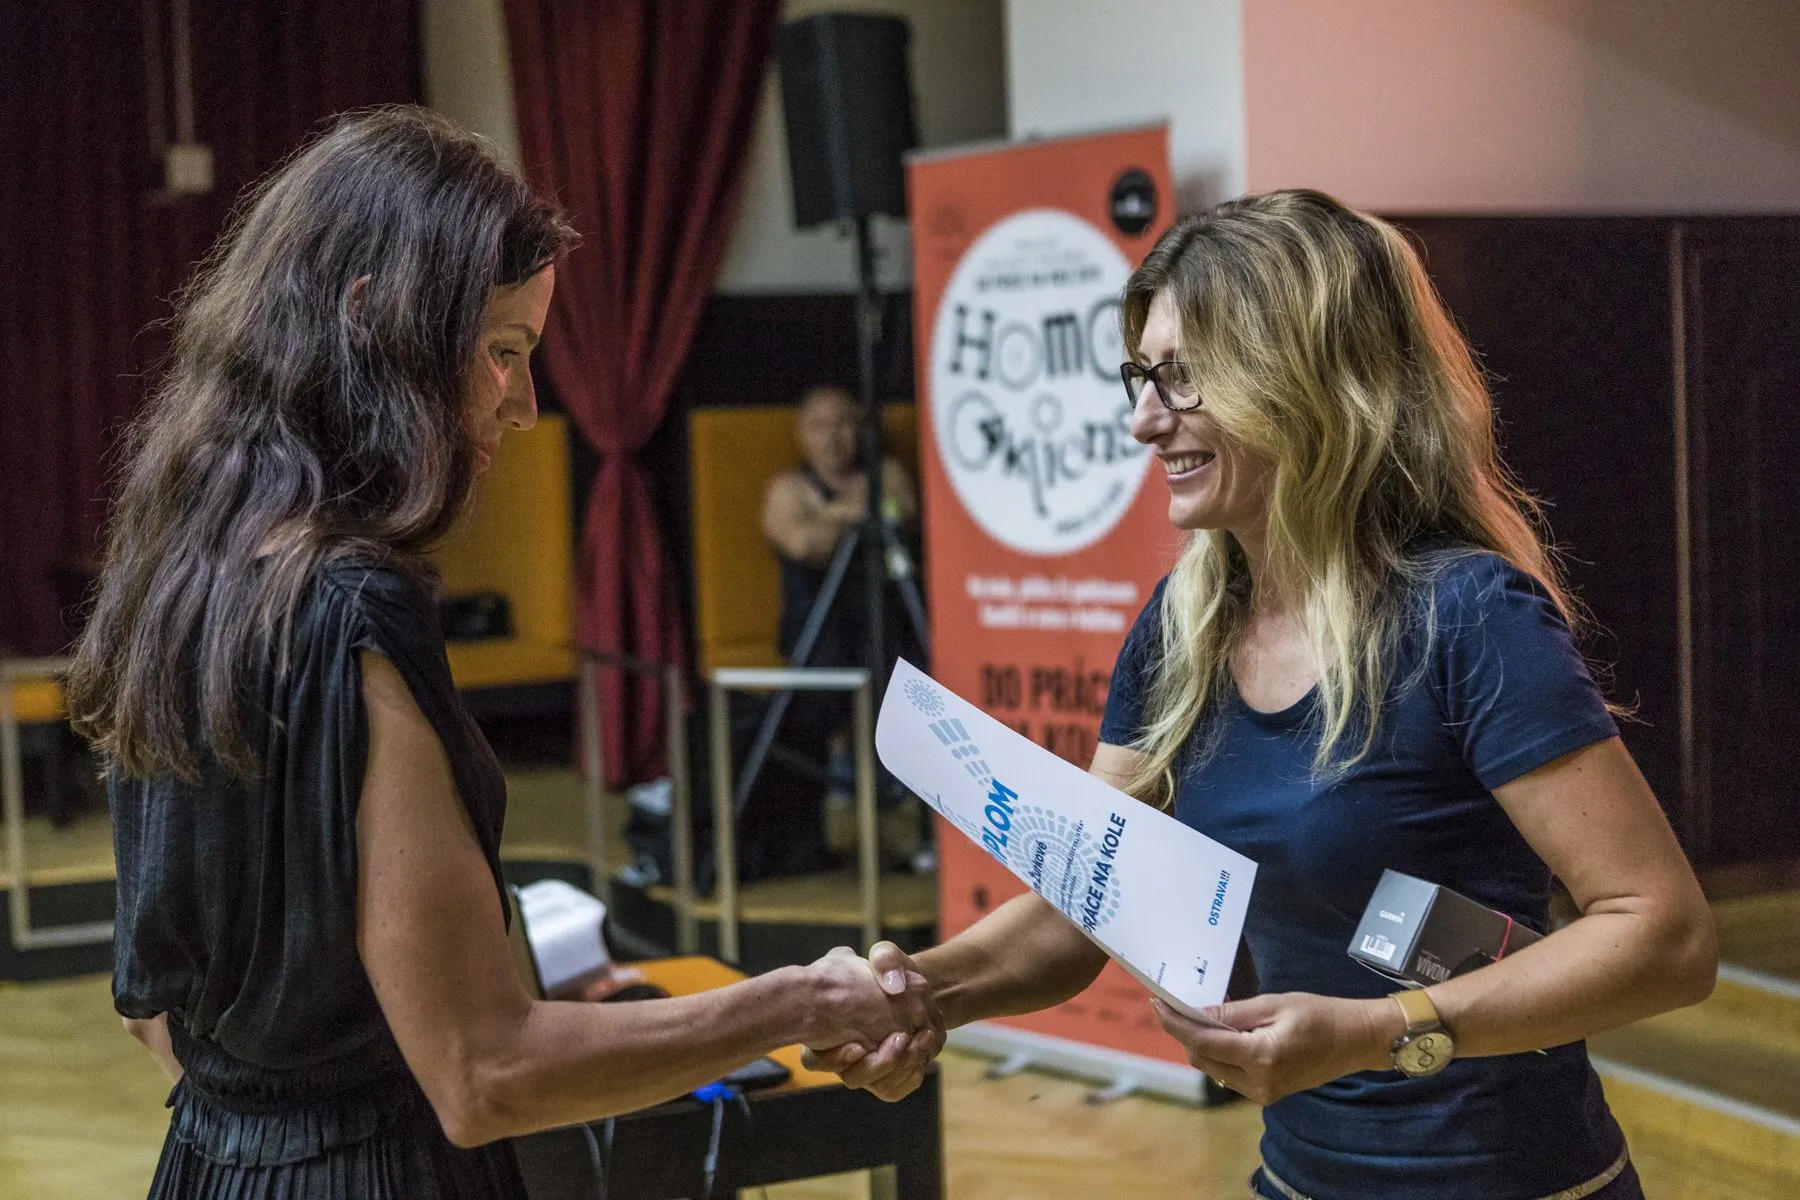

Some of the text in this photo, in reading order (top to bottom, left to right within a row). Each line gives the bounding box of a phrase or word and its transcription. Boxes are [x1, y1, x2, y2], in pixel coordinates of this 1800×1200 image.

[1029, 655, 1111, 717] PRÁC
[1099, 812, 1127, 860] KOLE
[1091, 860, 1113, 888] NA
[1207, 869, 1231, 926] OSTRAVA!!!
